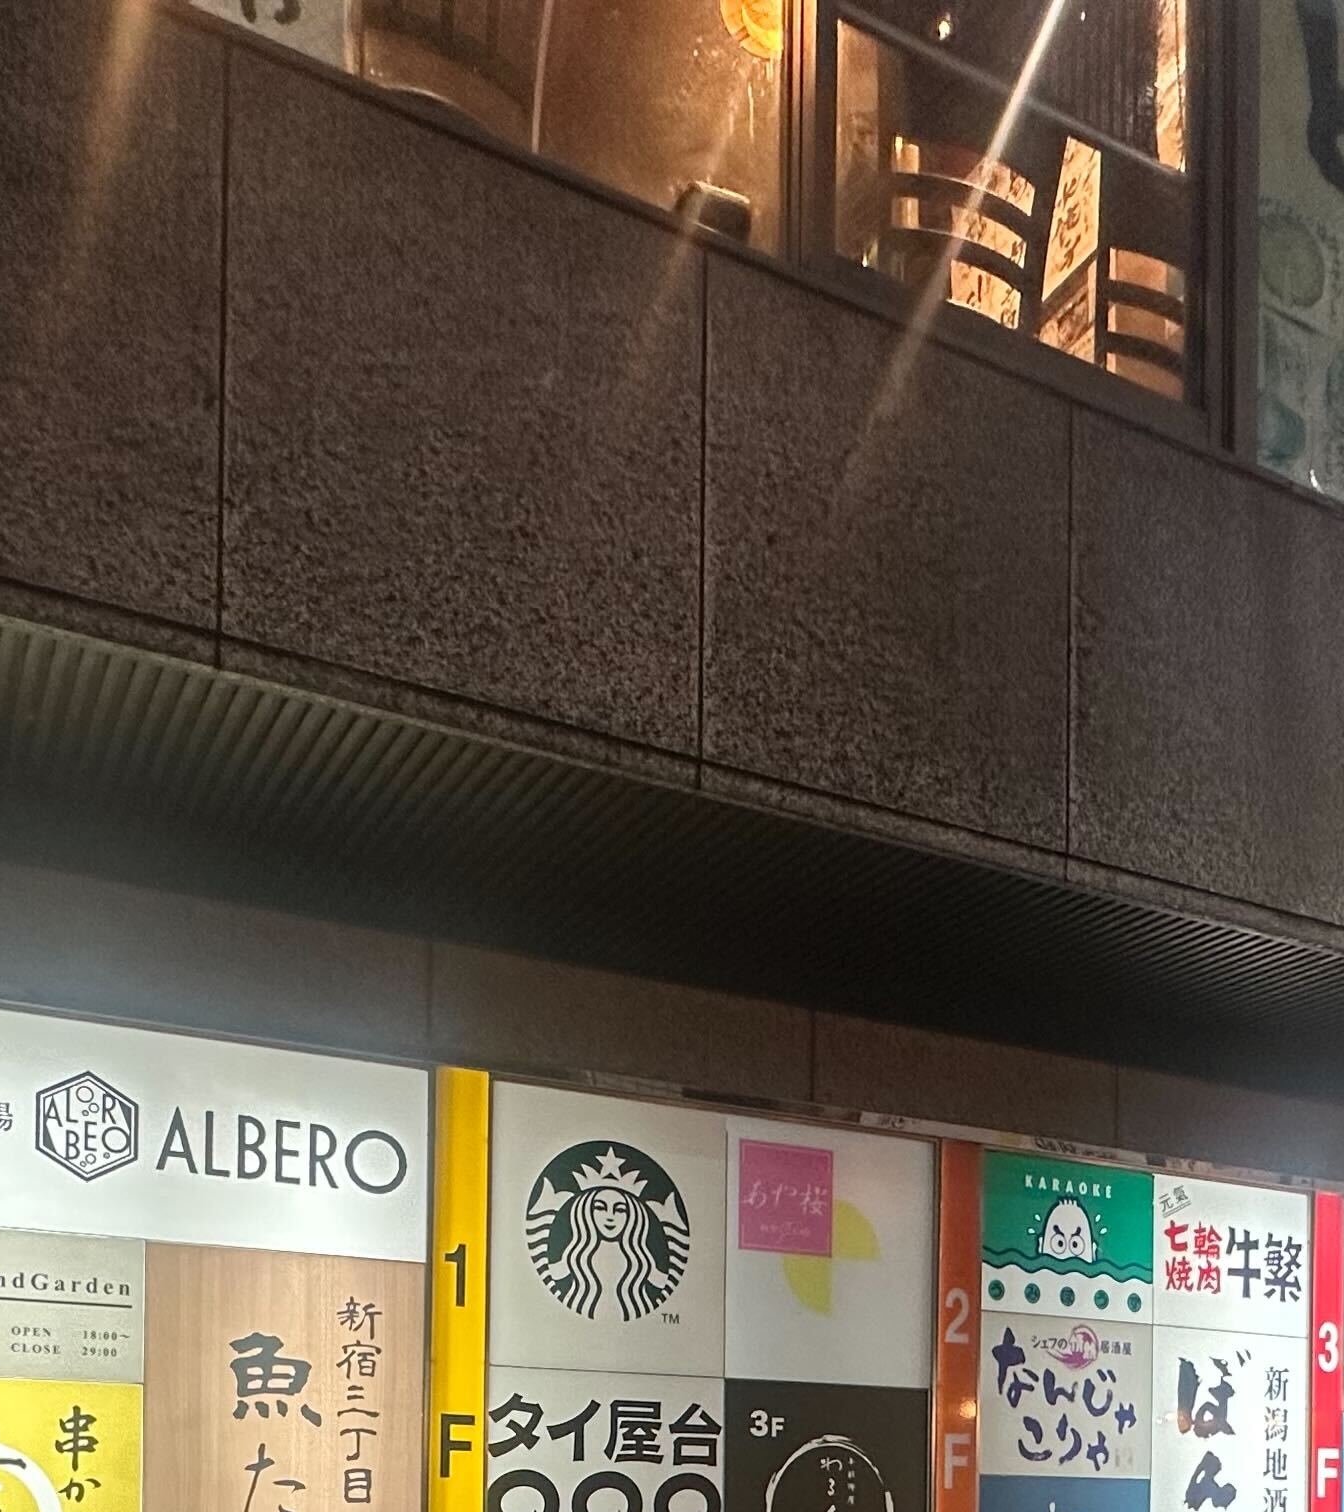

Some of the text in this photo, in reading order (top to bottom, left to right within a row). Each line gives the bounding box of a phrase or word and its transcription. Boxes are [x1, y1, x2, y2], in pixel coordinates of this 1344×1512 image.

[156, 1106, 408, 1195] ALBERO
[1024, 1174, 1112, 1199] KARAOKE
[1225, 1225, 1303, 1303] 牛繁
[10, 1342, 118, 1358] CLOSE 29:00
[11, 1325, 52, 1338] OPEN
[1100, 1341, 1133, 1356] 居酒屋
[336, 1296, 383, 1503] 新宿三丁目
[991, 1326, 1137, 1435] なんじゃ
[488, 1393, 722, 1467] タイ屋台
[749, 1409, 785, 1438] 3F
[1017, 1413, 1109, 1472] こりゃ
